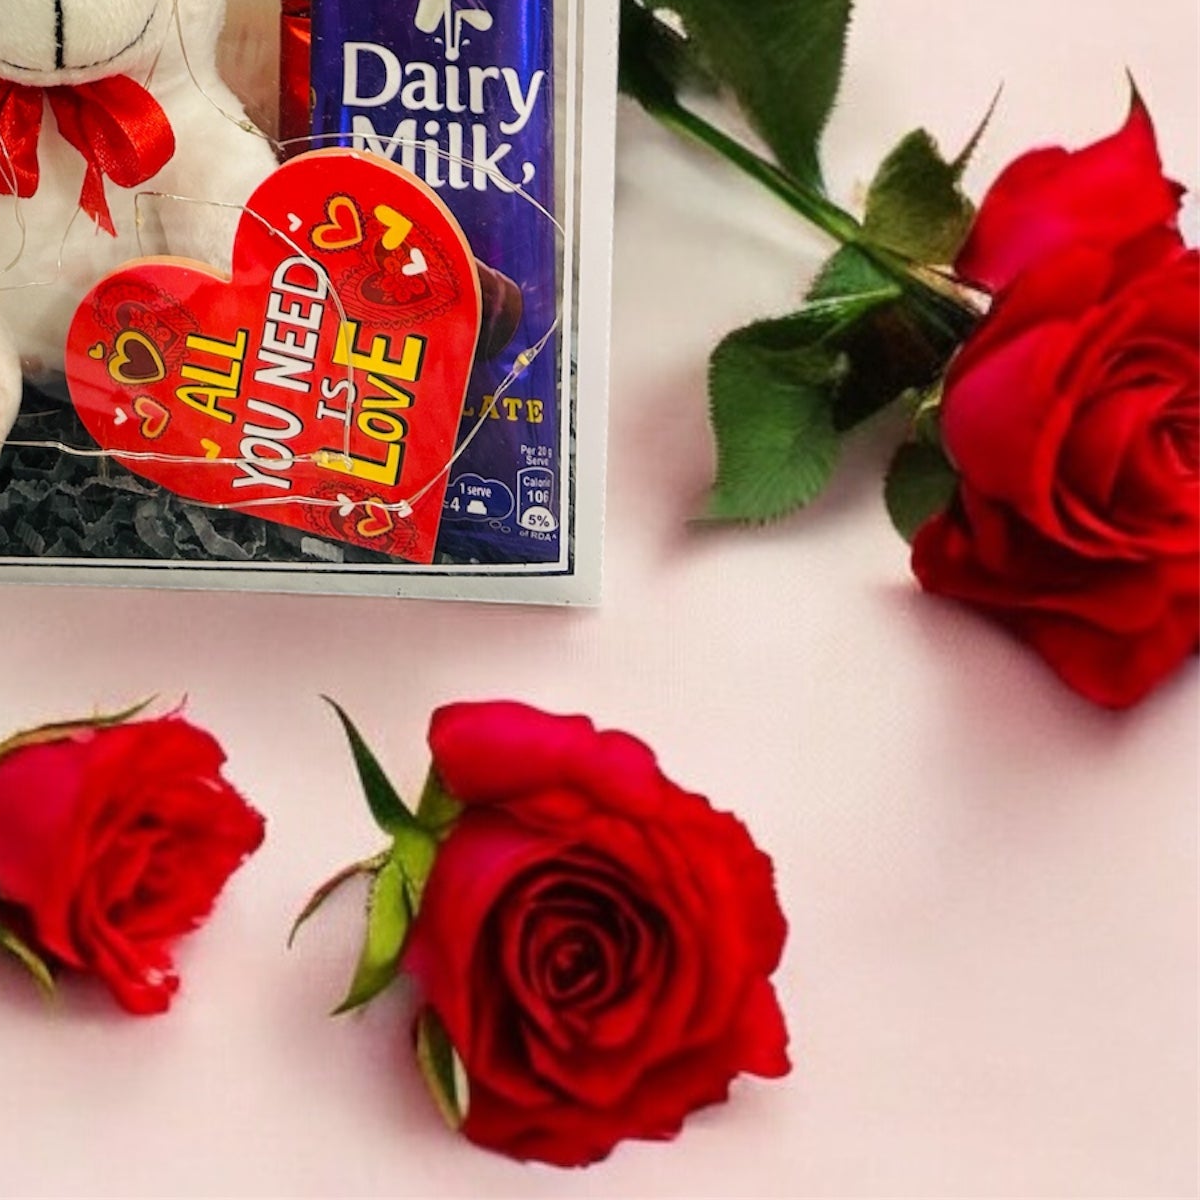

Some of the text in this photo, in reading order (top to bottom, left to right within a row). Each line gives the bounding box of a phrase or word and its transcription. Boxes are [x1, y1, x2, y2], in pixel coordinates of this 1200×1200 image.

[342, 42, 544, 135] Dairy
[352, 115, 521, 193] Milk
[176, 328, 248, 424] ALL
[232, 255, 331, 489] YOU NEED
[315, 377, 356, 425] IS
[316, 319, 427, 487] LOVE
[463, 394, 543, 423] ATE
[520, 444, 536, 457] Per
[526, 456, 549, 466] Serve
[460, 482, 492, 498] 1 serve
[528, 514, 550, 528] 5%
